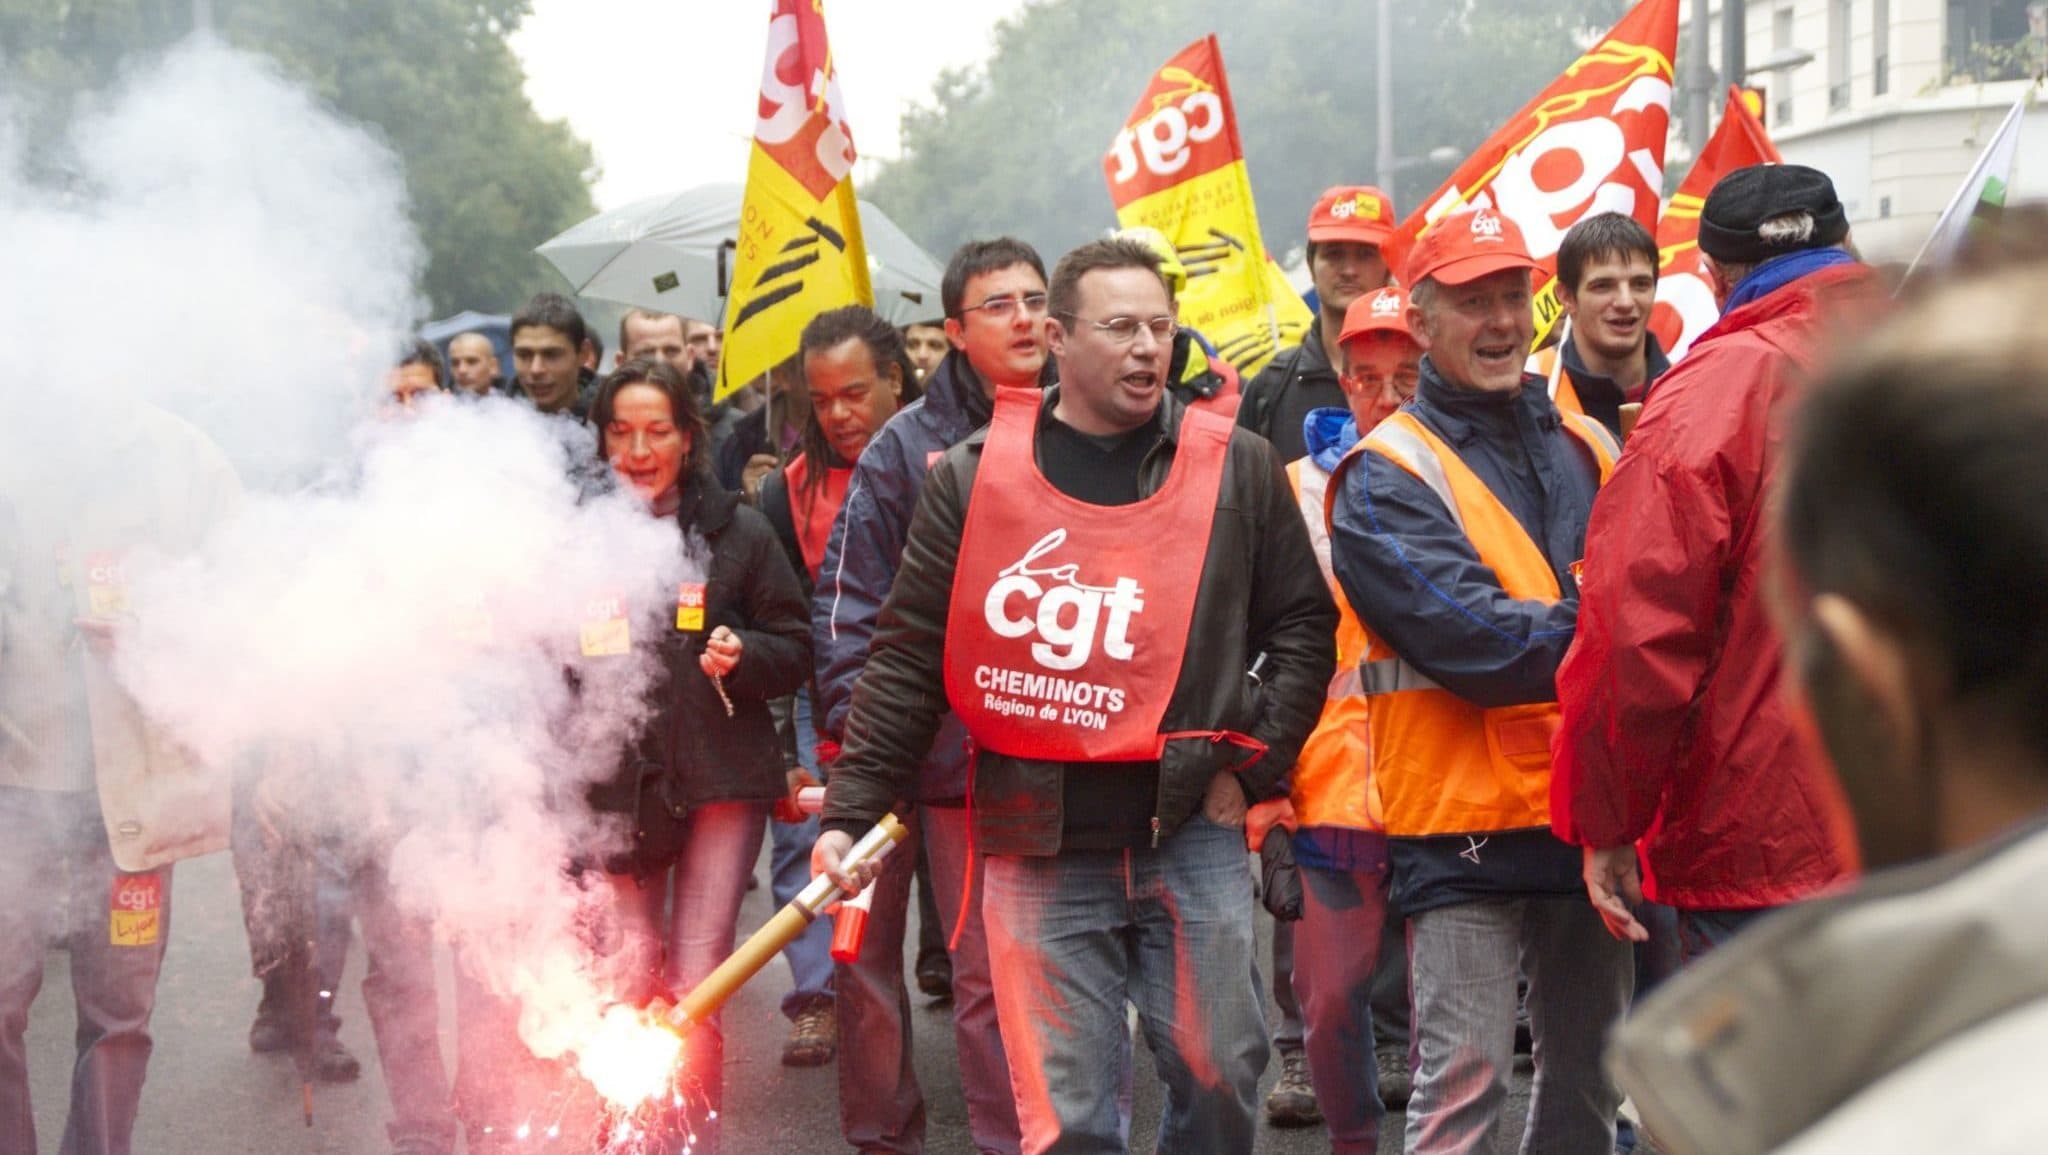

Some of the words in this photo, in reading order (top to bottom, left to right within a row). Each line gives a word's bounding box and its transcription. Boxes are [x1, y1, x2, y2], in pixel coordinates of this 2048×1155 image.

[1330, 199, 1356, 219] cgt
[999, 528, 1120, 592] la
[680, 591, 704, 607] cgt
[984, 576, 1144, 671] cgt
[974, 664, 1126, 713] CHEMINOTS
[983, 692, 1036, 718] Région
[1039, 702, 1058, 721] de
[1062, 708, 1108, 730] LYON
[118, 885, 156, 910] cgt
